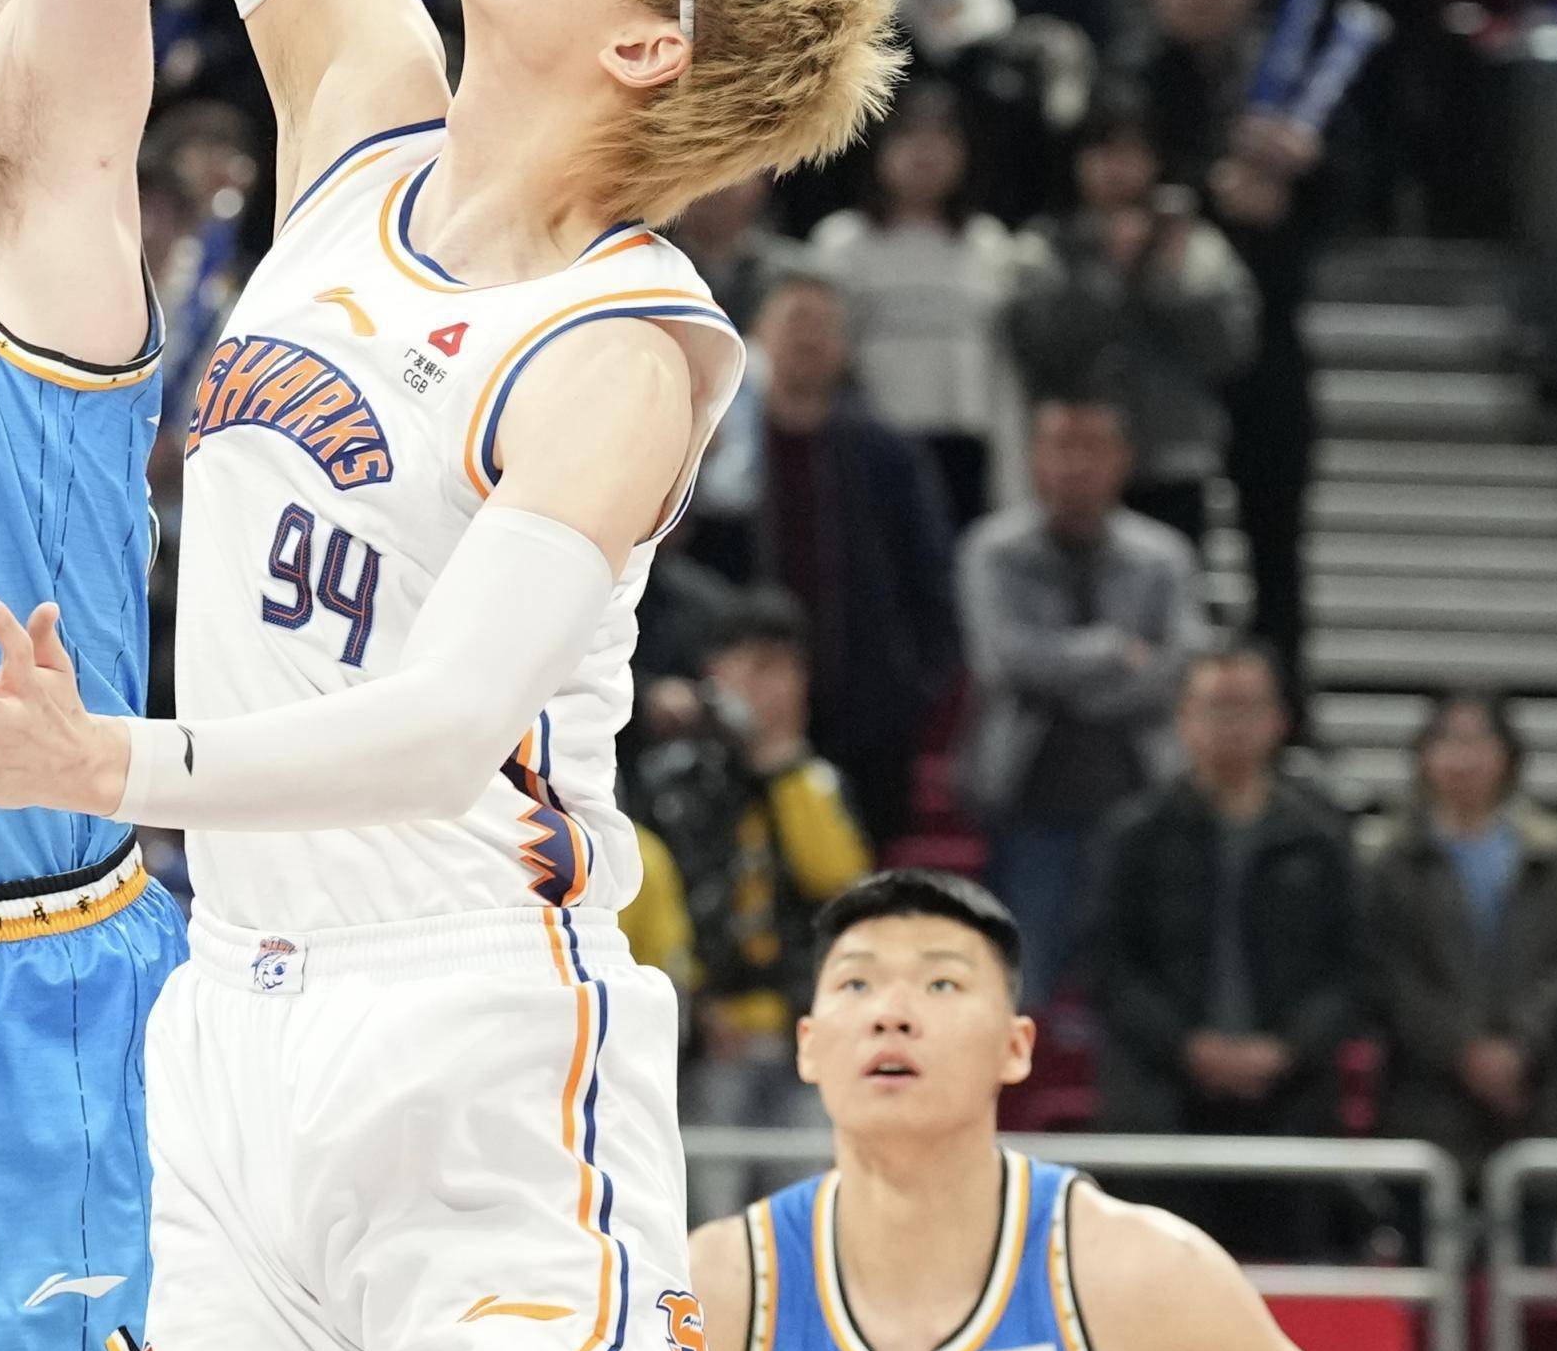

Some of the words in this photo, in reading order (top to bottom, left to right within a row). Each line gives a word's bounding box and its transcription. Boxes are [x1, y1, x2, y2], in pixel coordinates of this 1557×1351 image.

[185, 334, 394, 491] SHARKS
[403, 368, 429, 394] CGB
[404, 347, 448, 385] 广发银行
[262, 502, 383, 668] 94
